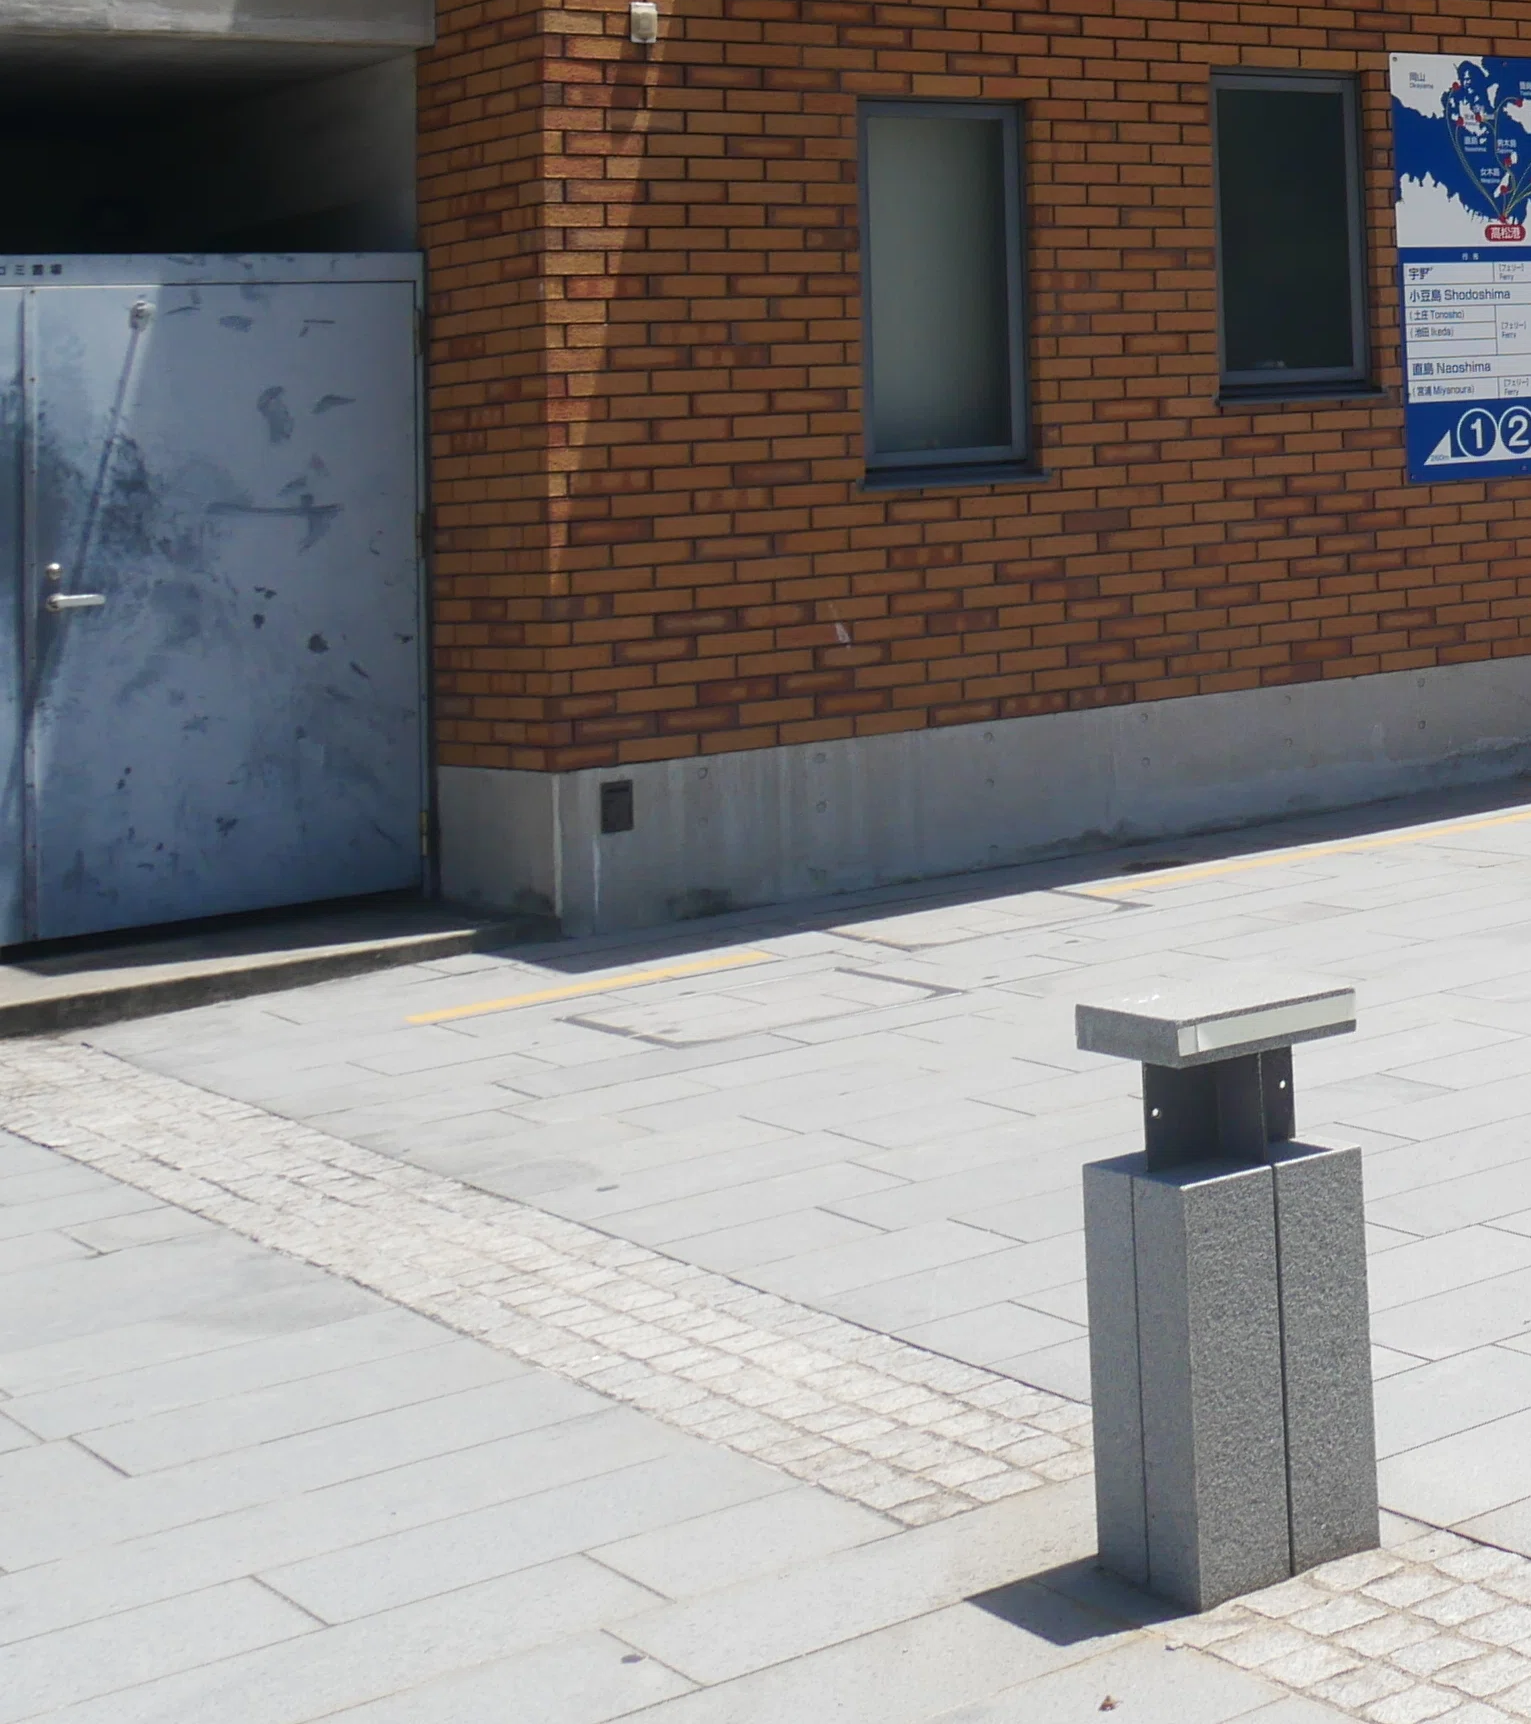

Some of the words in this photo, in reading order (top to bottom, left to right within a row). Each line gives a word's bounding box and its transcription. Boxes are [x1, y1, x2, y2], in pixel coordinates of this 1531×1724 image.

[1490, 226, 1521, 240] 高松港
[1409, 289, 1442, 303] 小豆島
[1444, 287, 1511, 301] Shodoshima
[1412, 362, 1434, 376] 直島
[1436, 361, 1492, 374] Naoshima
